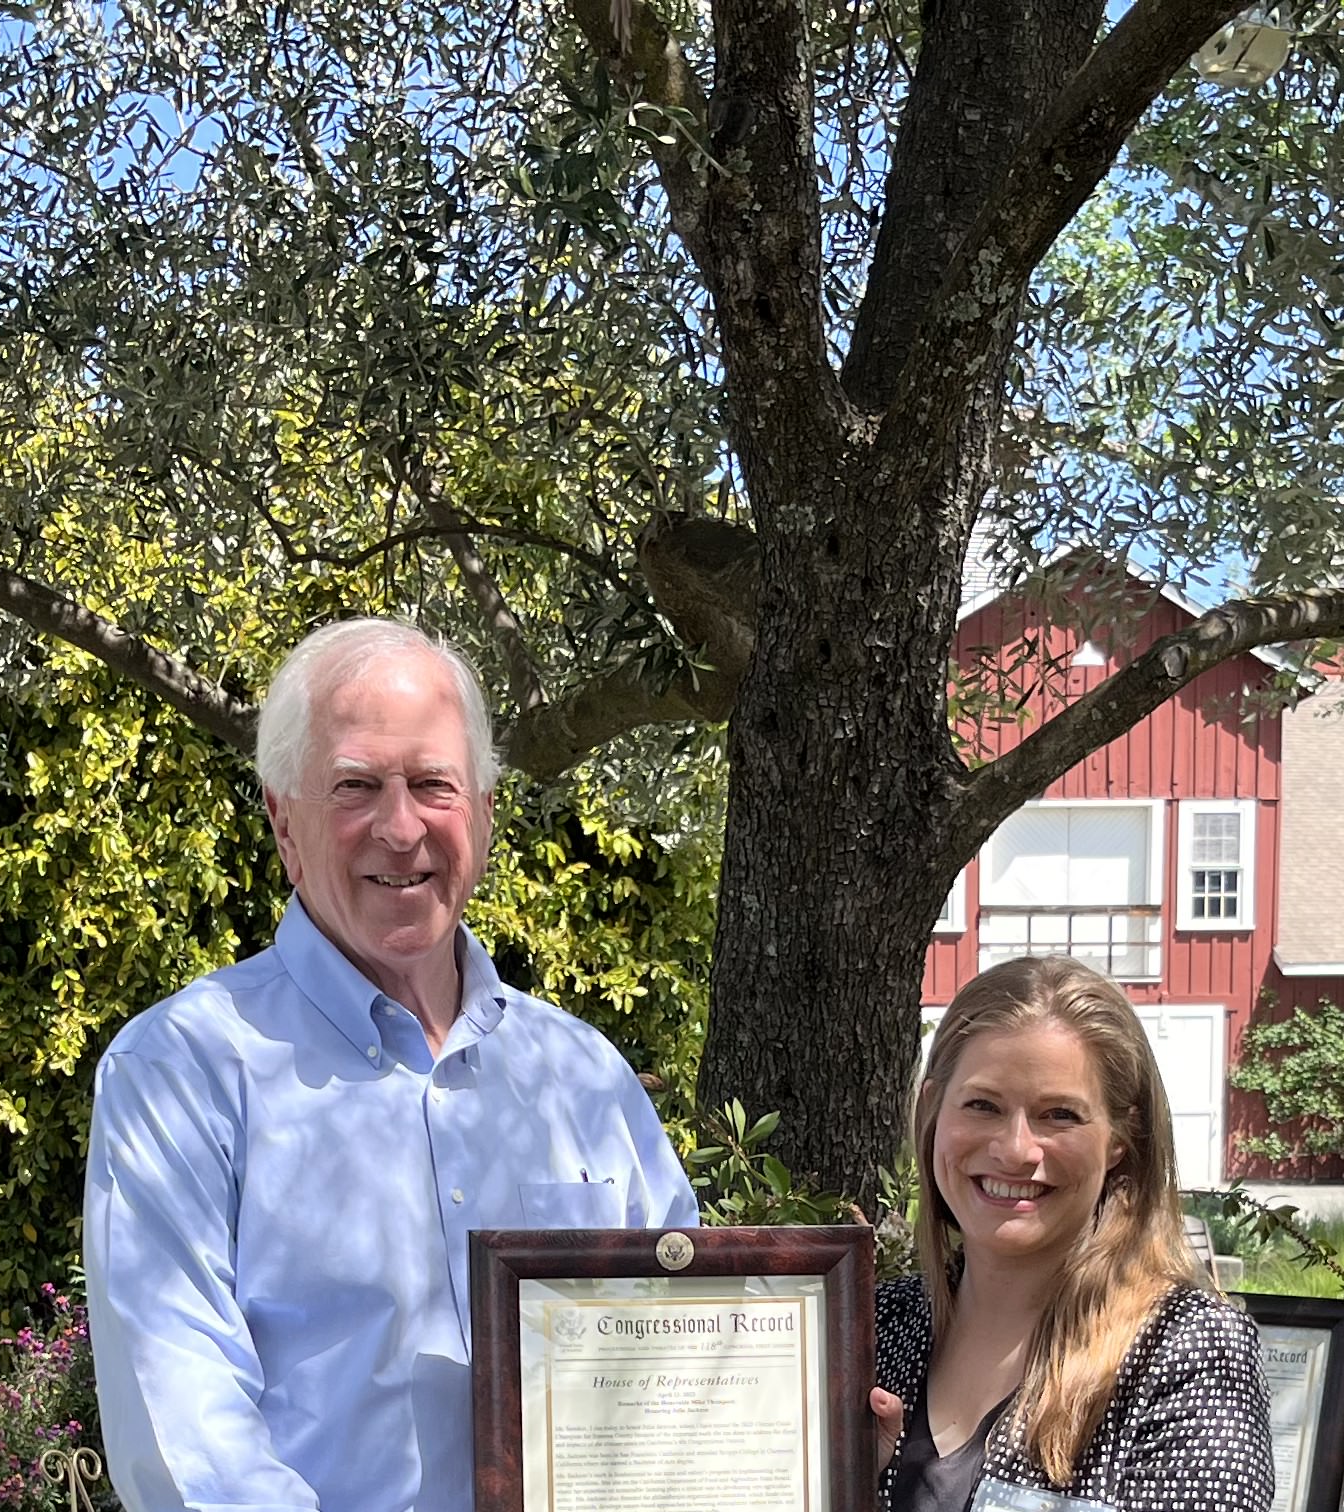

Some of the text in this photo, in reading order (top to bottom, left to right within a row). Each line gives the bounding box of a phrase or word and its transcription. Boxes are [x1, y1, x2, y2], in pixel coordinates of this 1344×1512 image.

[597, 1312, 795, 1340] Congressional Record
[1267, 1347, 1308, 1364] Record
[593, 1374, 760, 1391] House of Representatives
